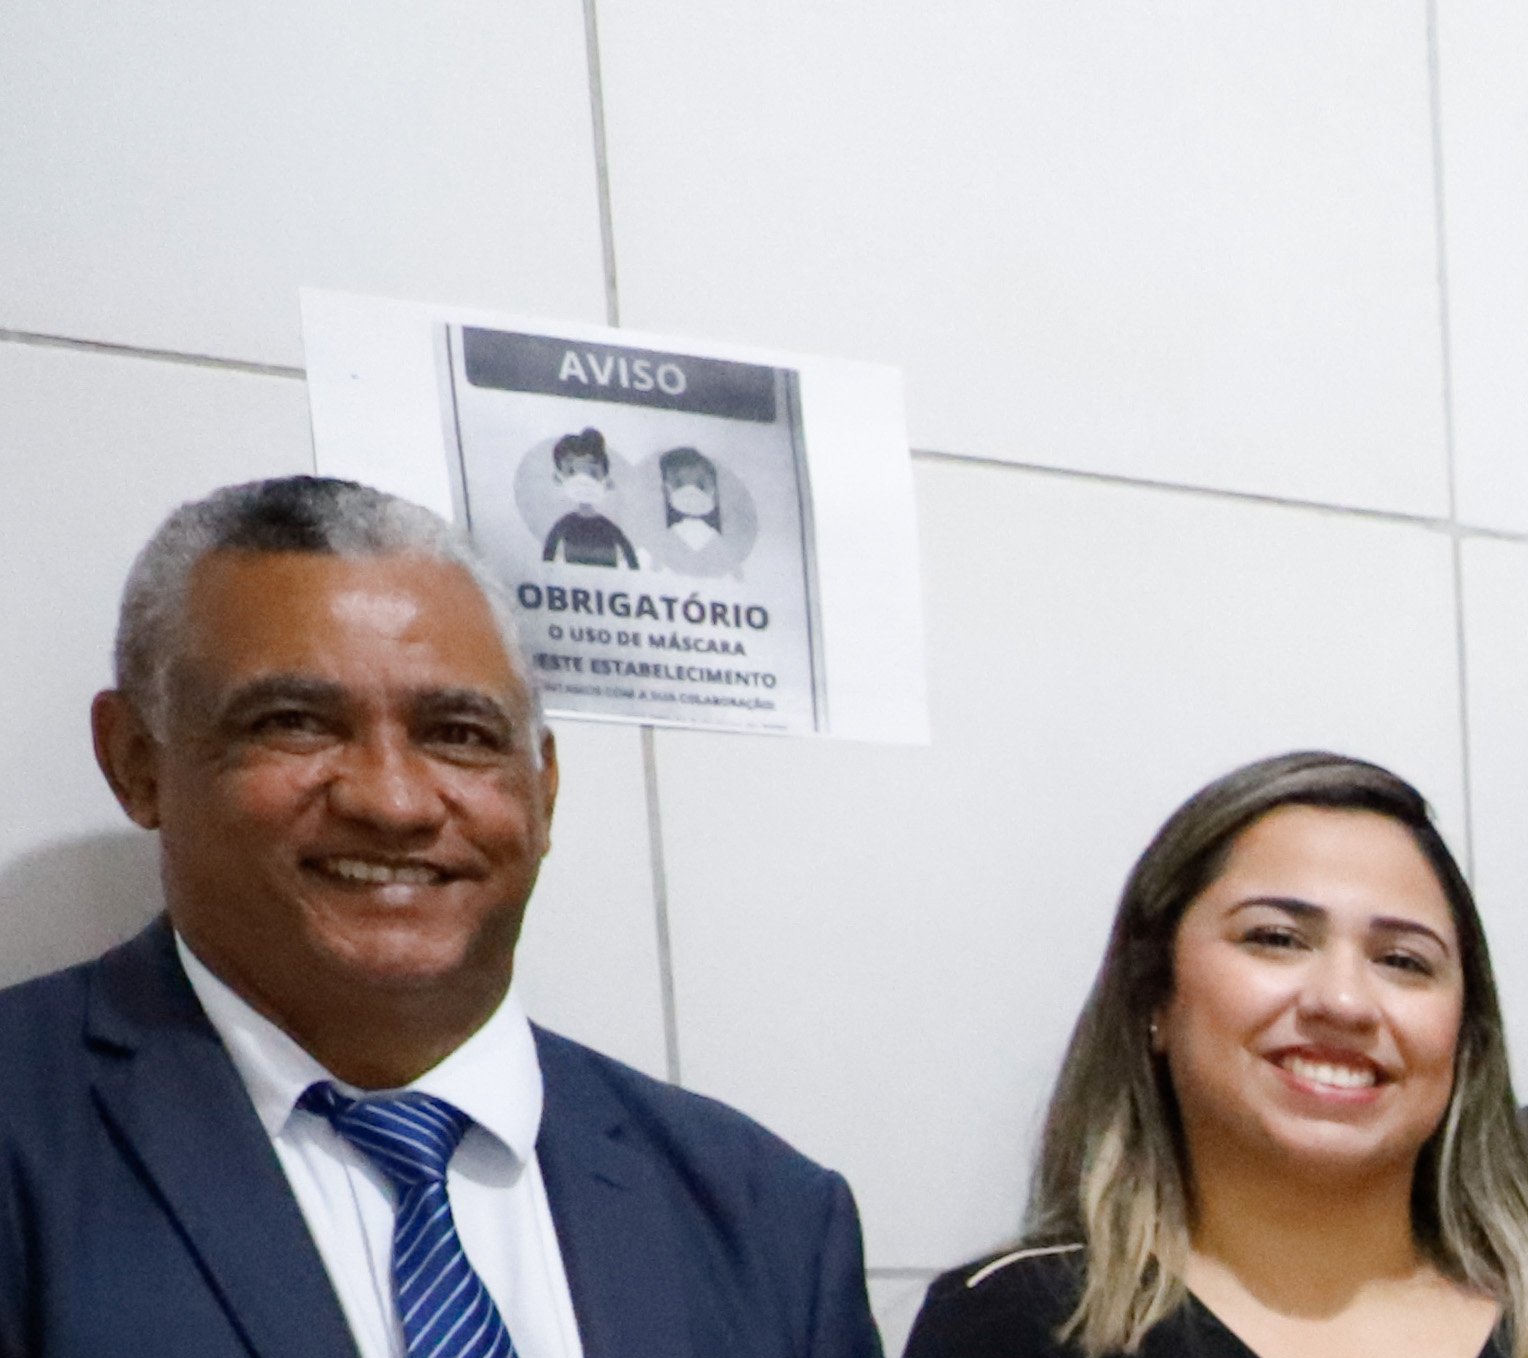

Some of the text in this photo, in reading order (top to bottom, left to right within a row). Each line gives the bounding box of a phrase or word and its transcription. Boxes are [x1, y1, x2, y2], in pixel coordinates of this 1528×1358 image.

[558, 350, 688, 396] AVISO
[517, 583, 769, 630] OBRIGATÓRIO
[548, 624, 746, 656] O USO DE MÁSCARA
[591, 657, 777, 689] ESTABELECIMENTO
